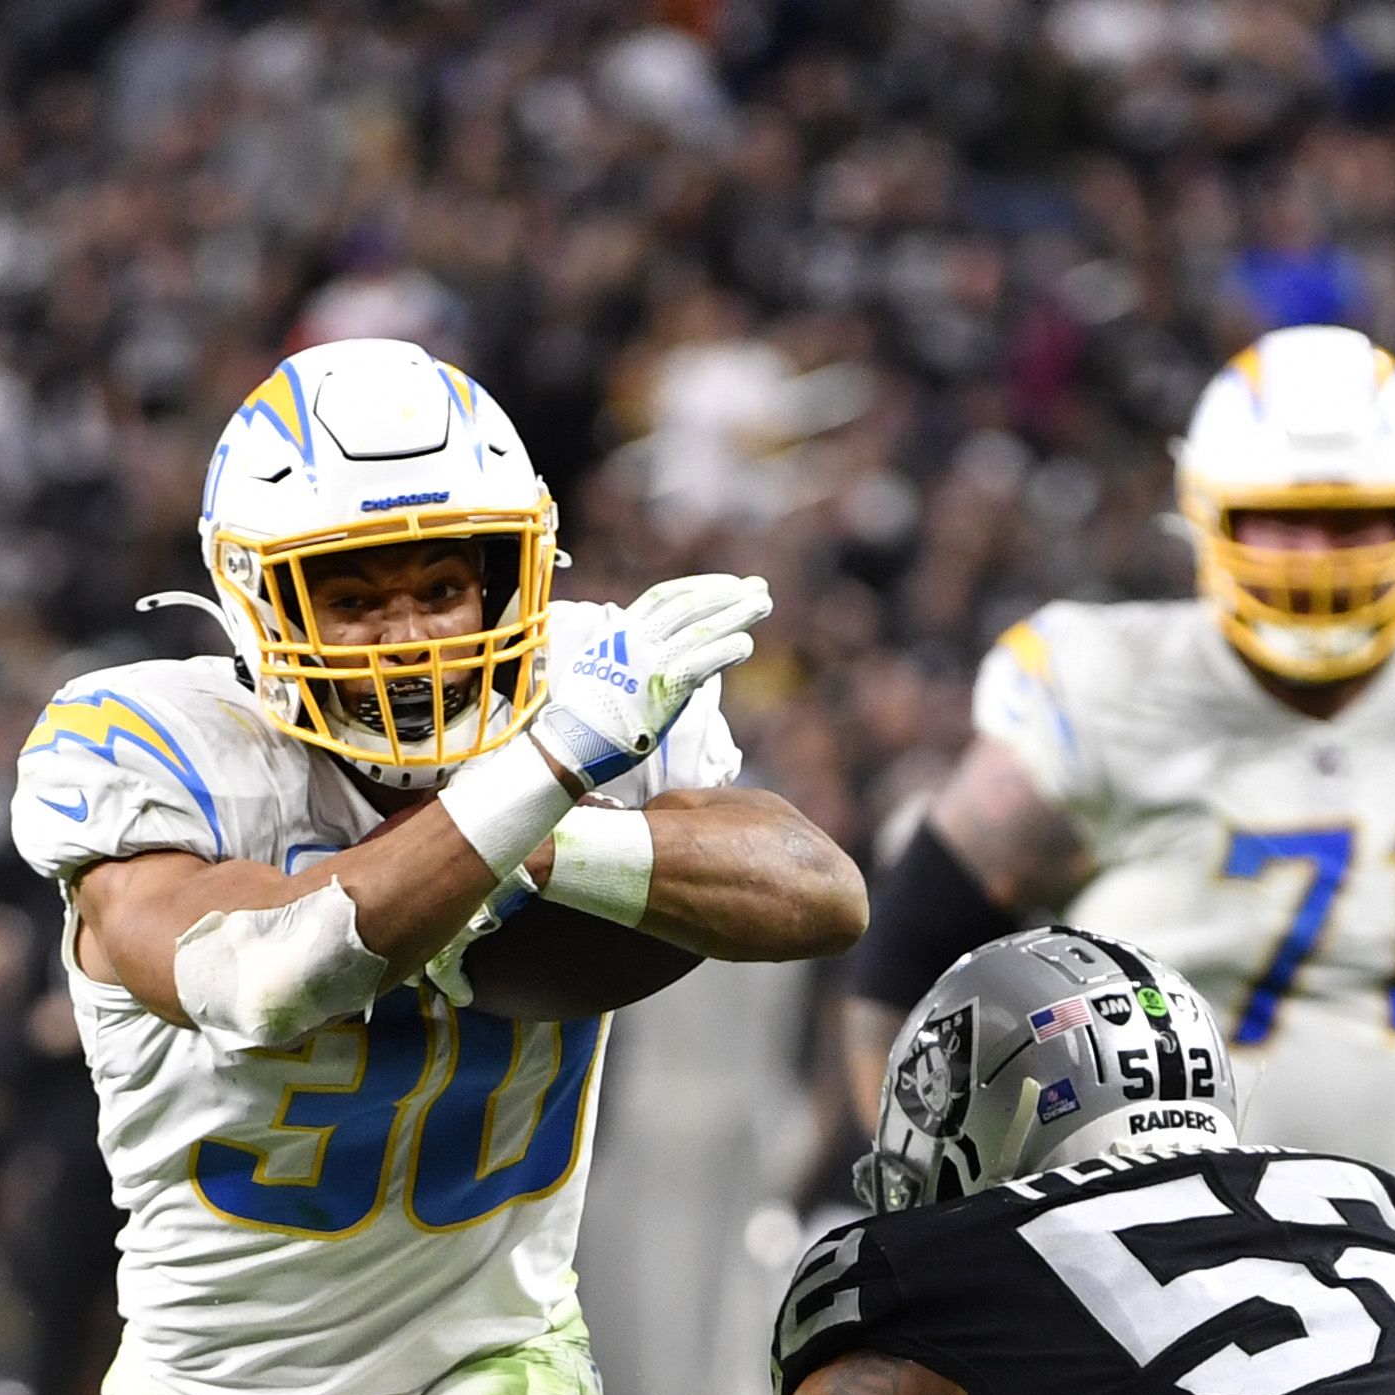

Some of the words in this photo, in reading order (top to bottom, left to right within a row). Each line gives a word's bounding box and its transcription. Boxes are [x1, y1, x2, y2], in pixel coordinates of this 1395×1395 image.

[572, 660, 639, 695] adidas
[1099, 998, 1131, 1017] JM
[187, 985, 607, 1242] 30
[1129, 1109, 1218, 1136] RAIDERS
